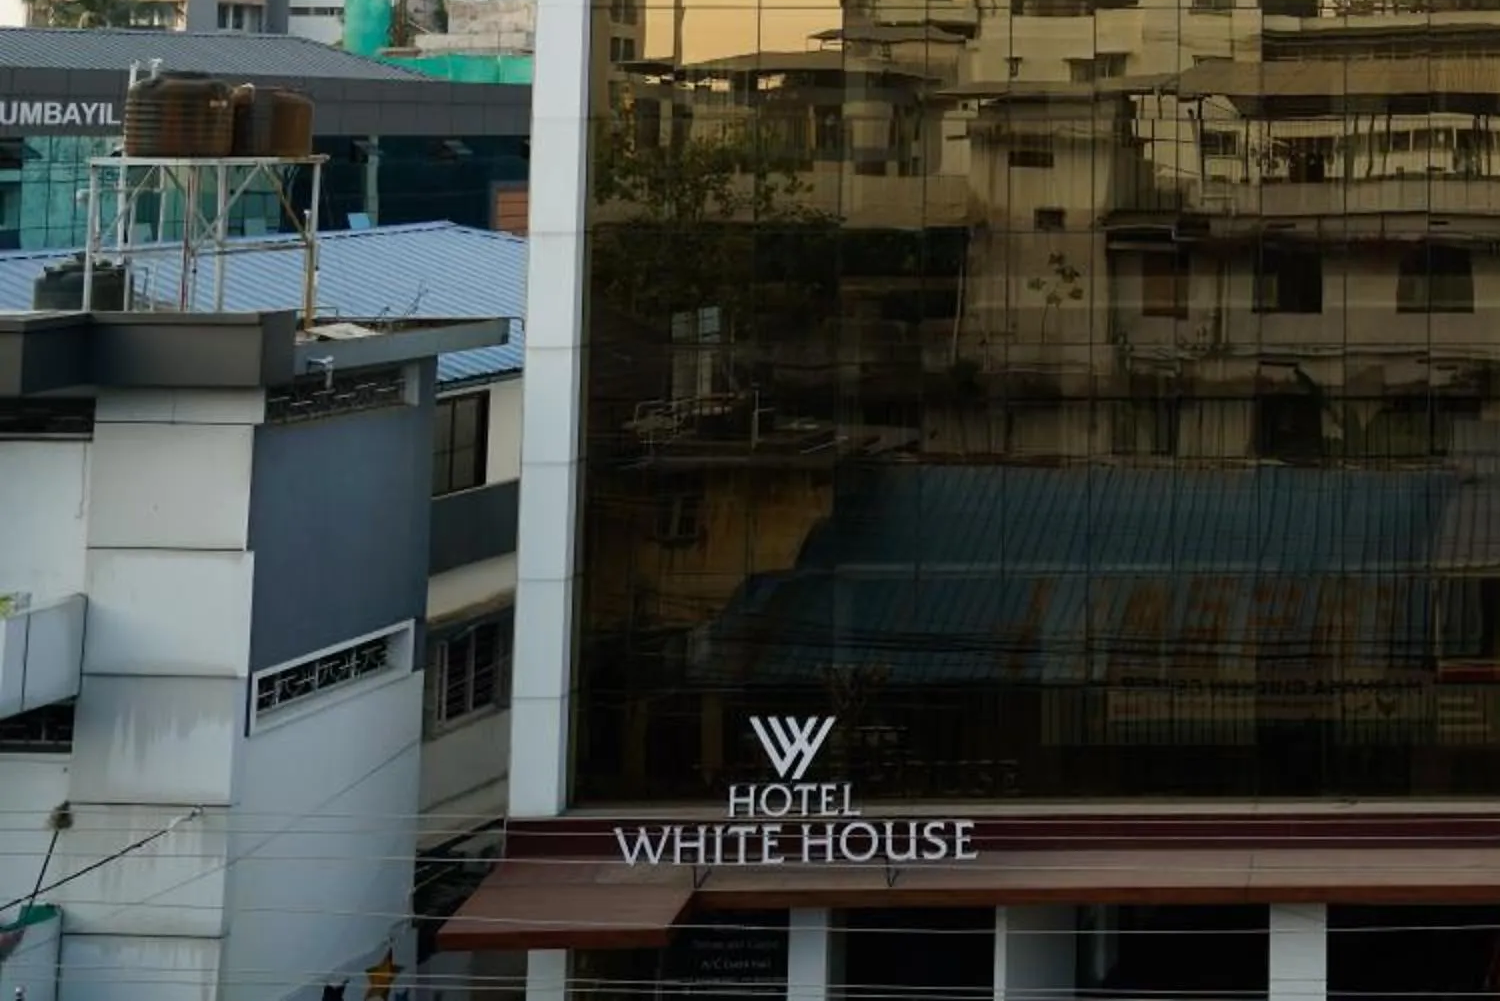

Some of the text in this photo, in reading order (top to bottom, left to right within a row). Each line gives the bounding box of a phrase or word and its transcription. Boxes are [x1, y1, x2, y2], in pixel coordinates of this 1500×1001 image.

[0, 101, 121, 125] UMBAYIL
[728, 783, 861, 818] HOTEL
[614, 819, 979, 866] WHITE HOUSE
